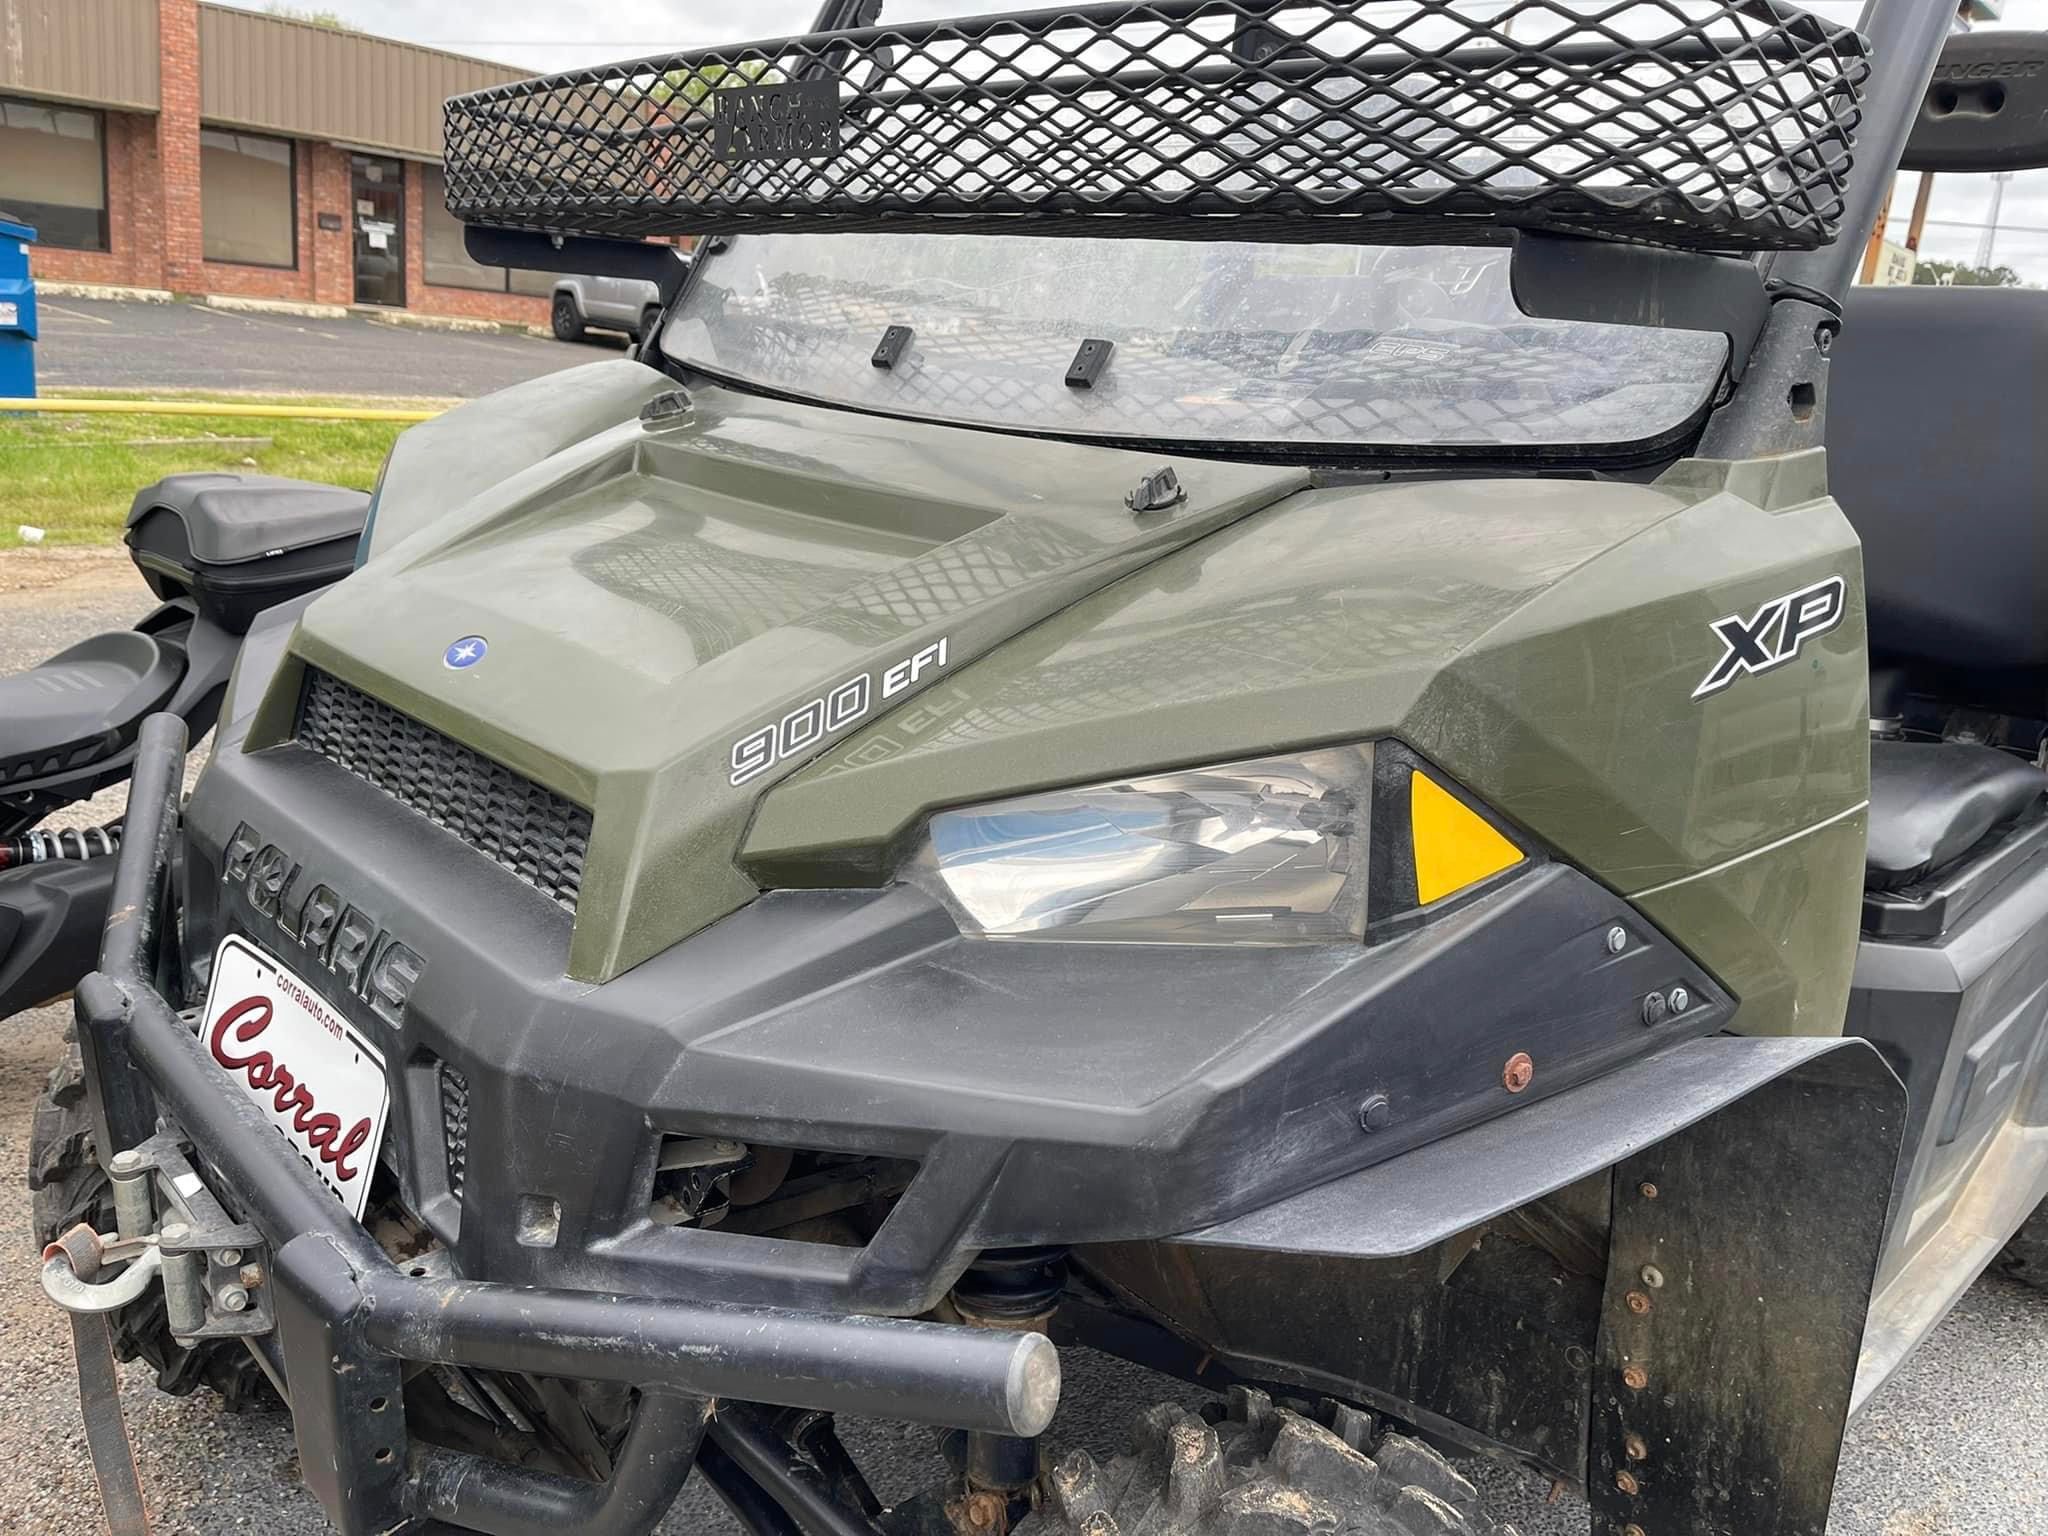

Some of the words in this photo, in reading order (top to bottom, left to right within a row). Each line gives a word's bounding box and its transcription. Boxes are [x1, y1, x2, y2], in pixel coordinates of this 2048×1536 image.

[730, 672, 871, 786] 900
[882, 636, 949, 699] EFI
[1690, 575, 1846, 701] XP
[222, 820, 427, 1030] POLARIS
[276, 972, 344, 1041] corralauto.com
[210, 995, 372, 1181] Corral
